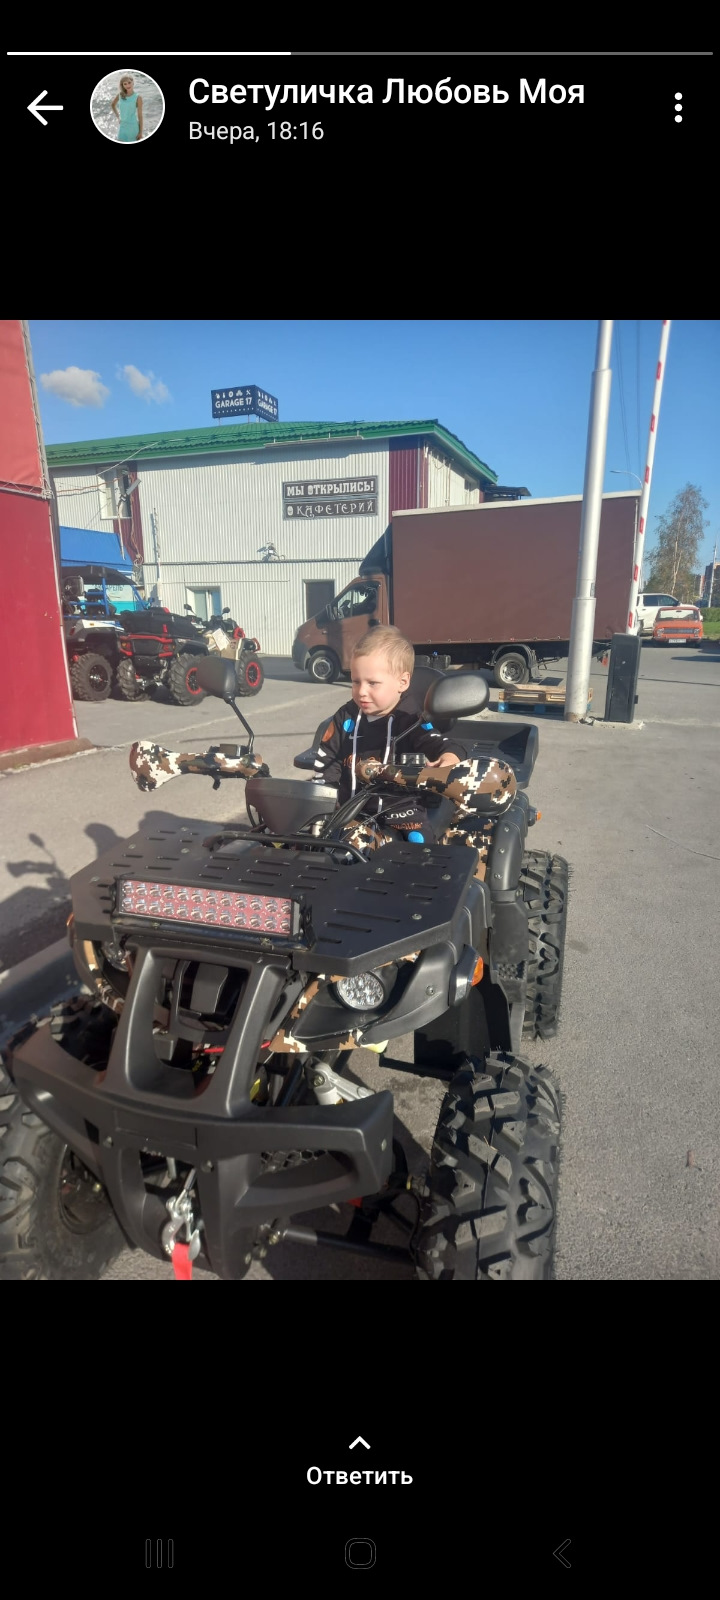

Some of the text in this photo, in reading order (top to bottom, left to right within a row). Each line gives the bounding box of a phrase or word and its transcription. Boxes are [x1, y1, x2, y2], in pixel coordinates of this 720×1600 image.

[215, 397, 253, 409] GARAGE 17
[286, 480, 375, 497] МЫ ОТКРЫЛИСЬ!
[296, 500, 374, 518] КАФЕТЕРИЙ
